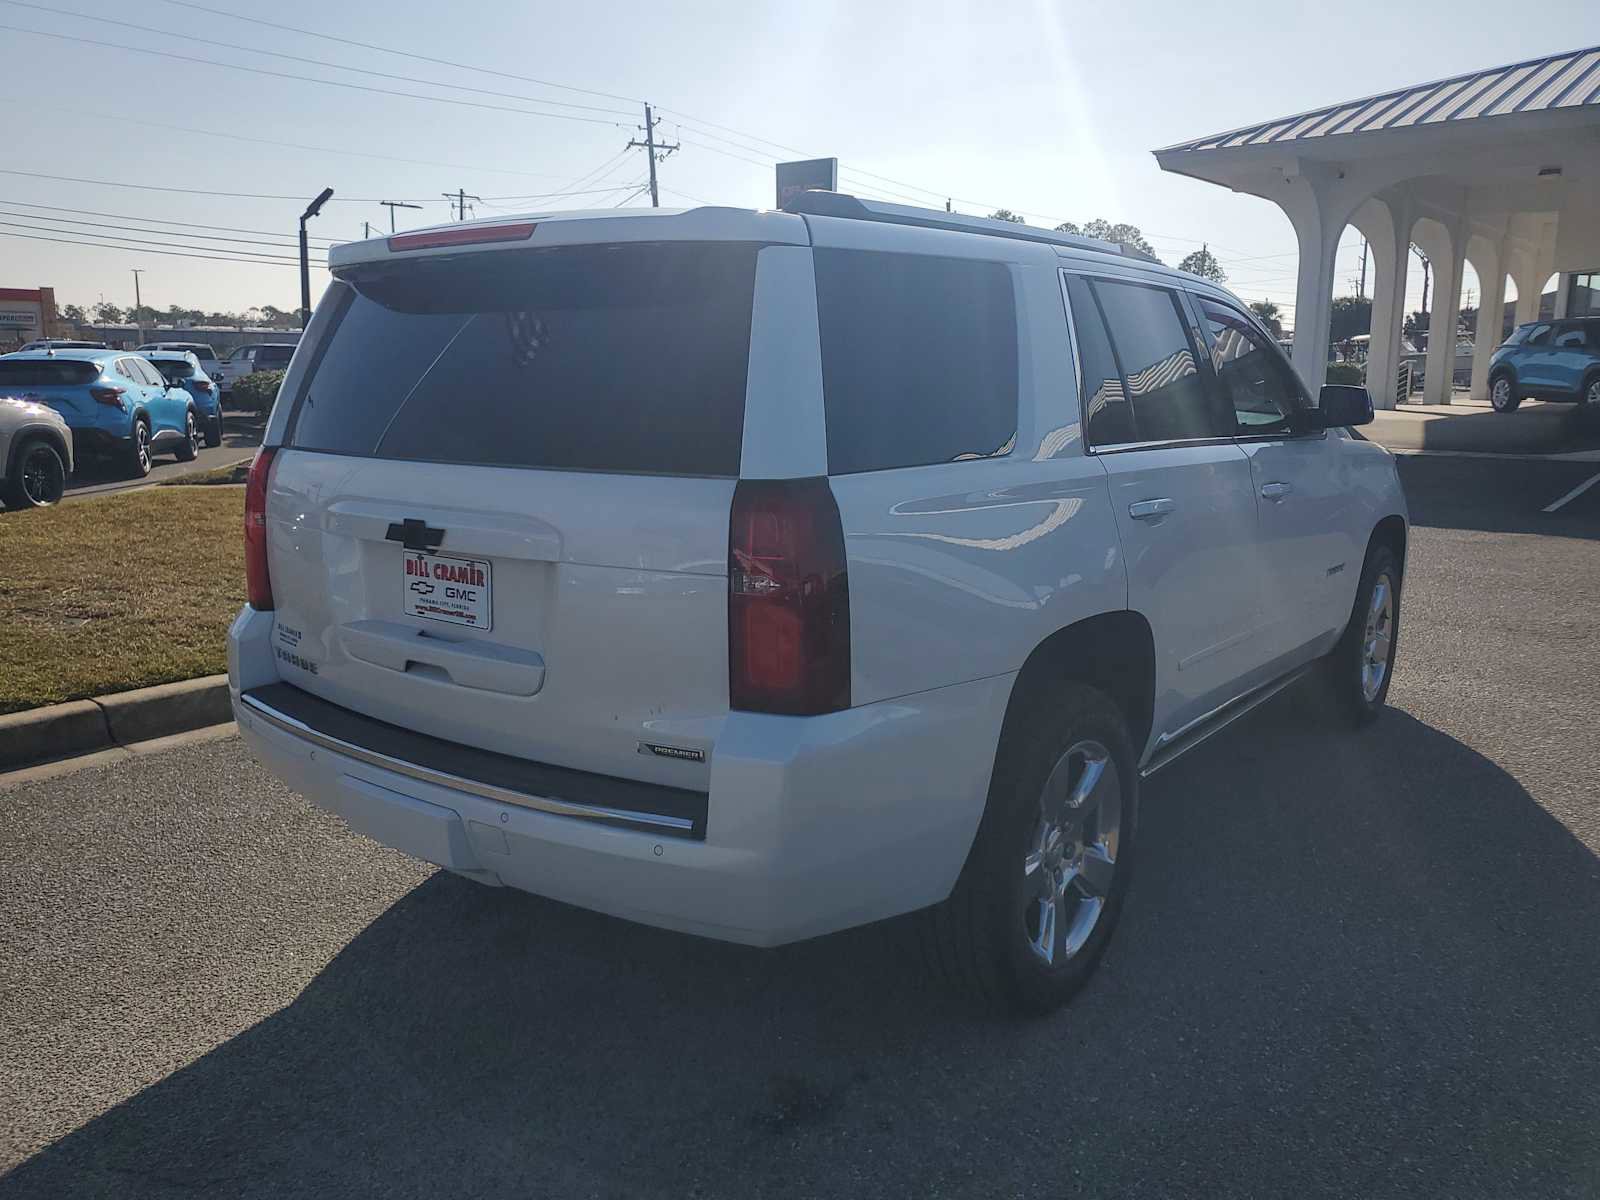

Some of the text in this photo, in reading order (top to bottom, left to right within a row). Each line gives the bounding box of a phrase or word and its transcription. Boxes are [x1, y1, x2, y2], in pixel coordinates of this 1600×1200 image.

[407, 559, 484, 587] BILL CRAMER
[445, 587, 476, 602] GMC
[655, 747, 701, 760] PREMIER
